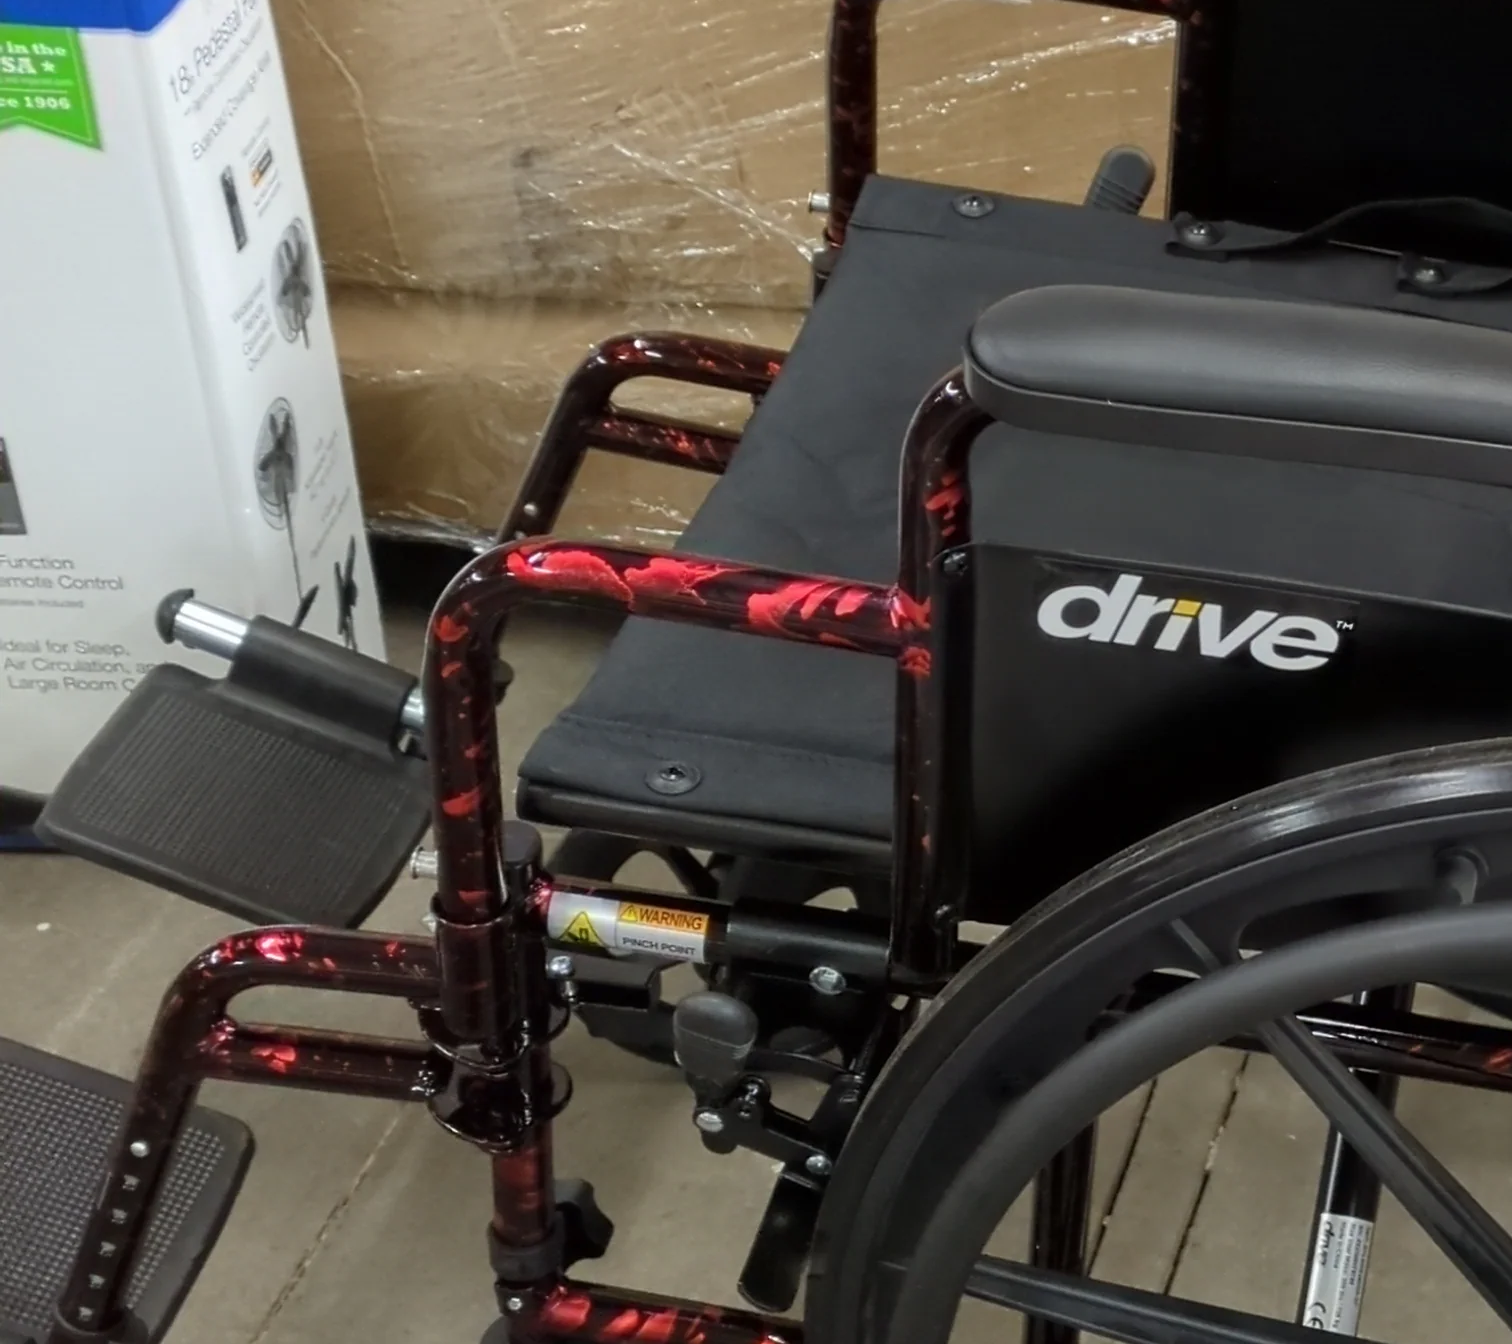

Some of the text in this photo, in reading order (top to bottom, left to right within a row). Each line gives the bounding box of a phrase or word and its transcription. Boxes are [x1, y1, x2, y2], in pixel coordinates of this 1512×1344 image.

[24, 96, 71, 110] 1906
[58, 575, 124, 590] Control
[1037, 573, 1339, 671] drive
[46, 640, 68, 653] for
[74, 640, 131, 657] Sleep,
[4, 657, 25, 671] Air
[31, 658, 131, 674] Circulation,
[7, 676, 59, 692] Large
[63, 676, 117, 691] Room
[639, 907, 702, 930] WARNING
[622, 937, 696, 956] PINCH POINT
